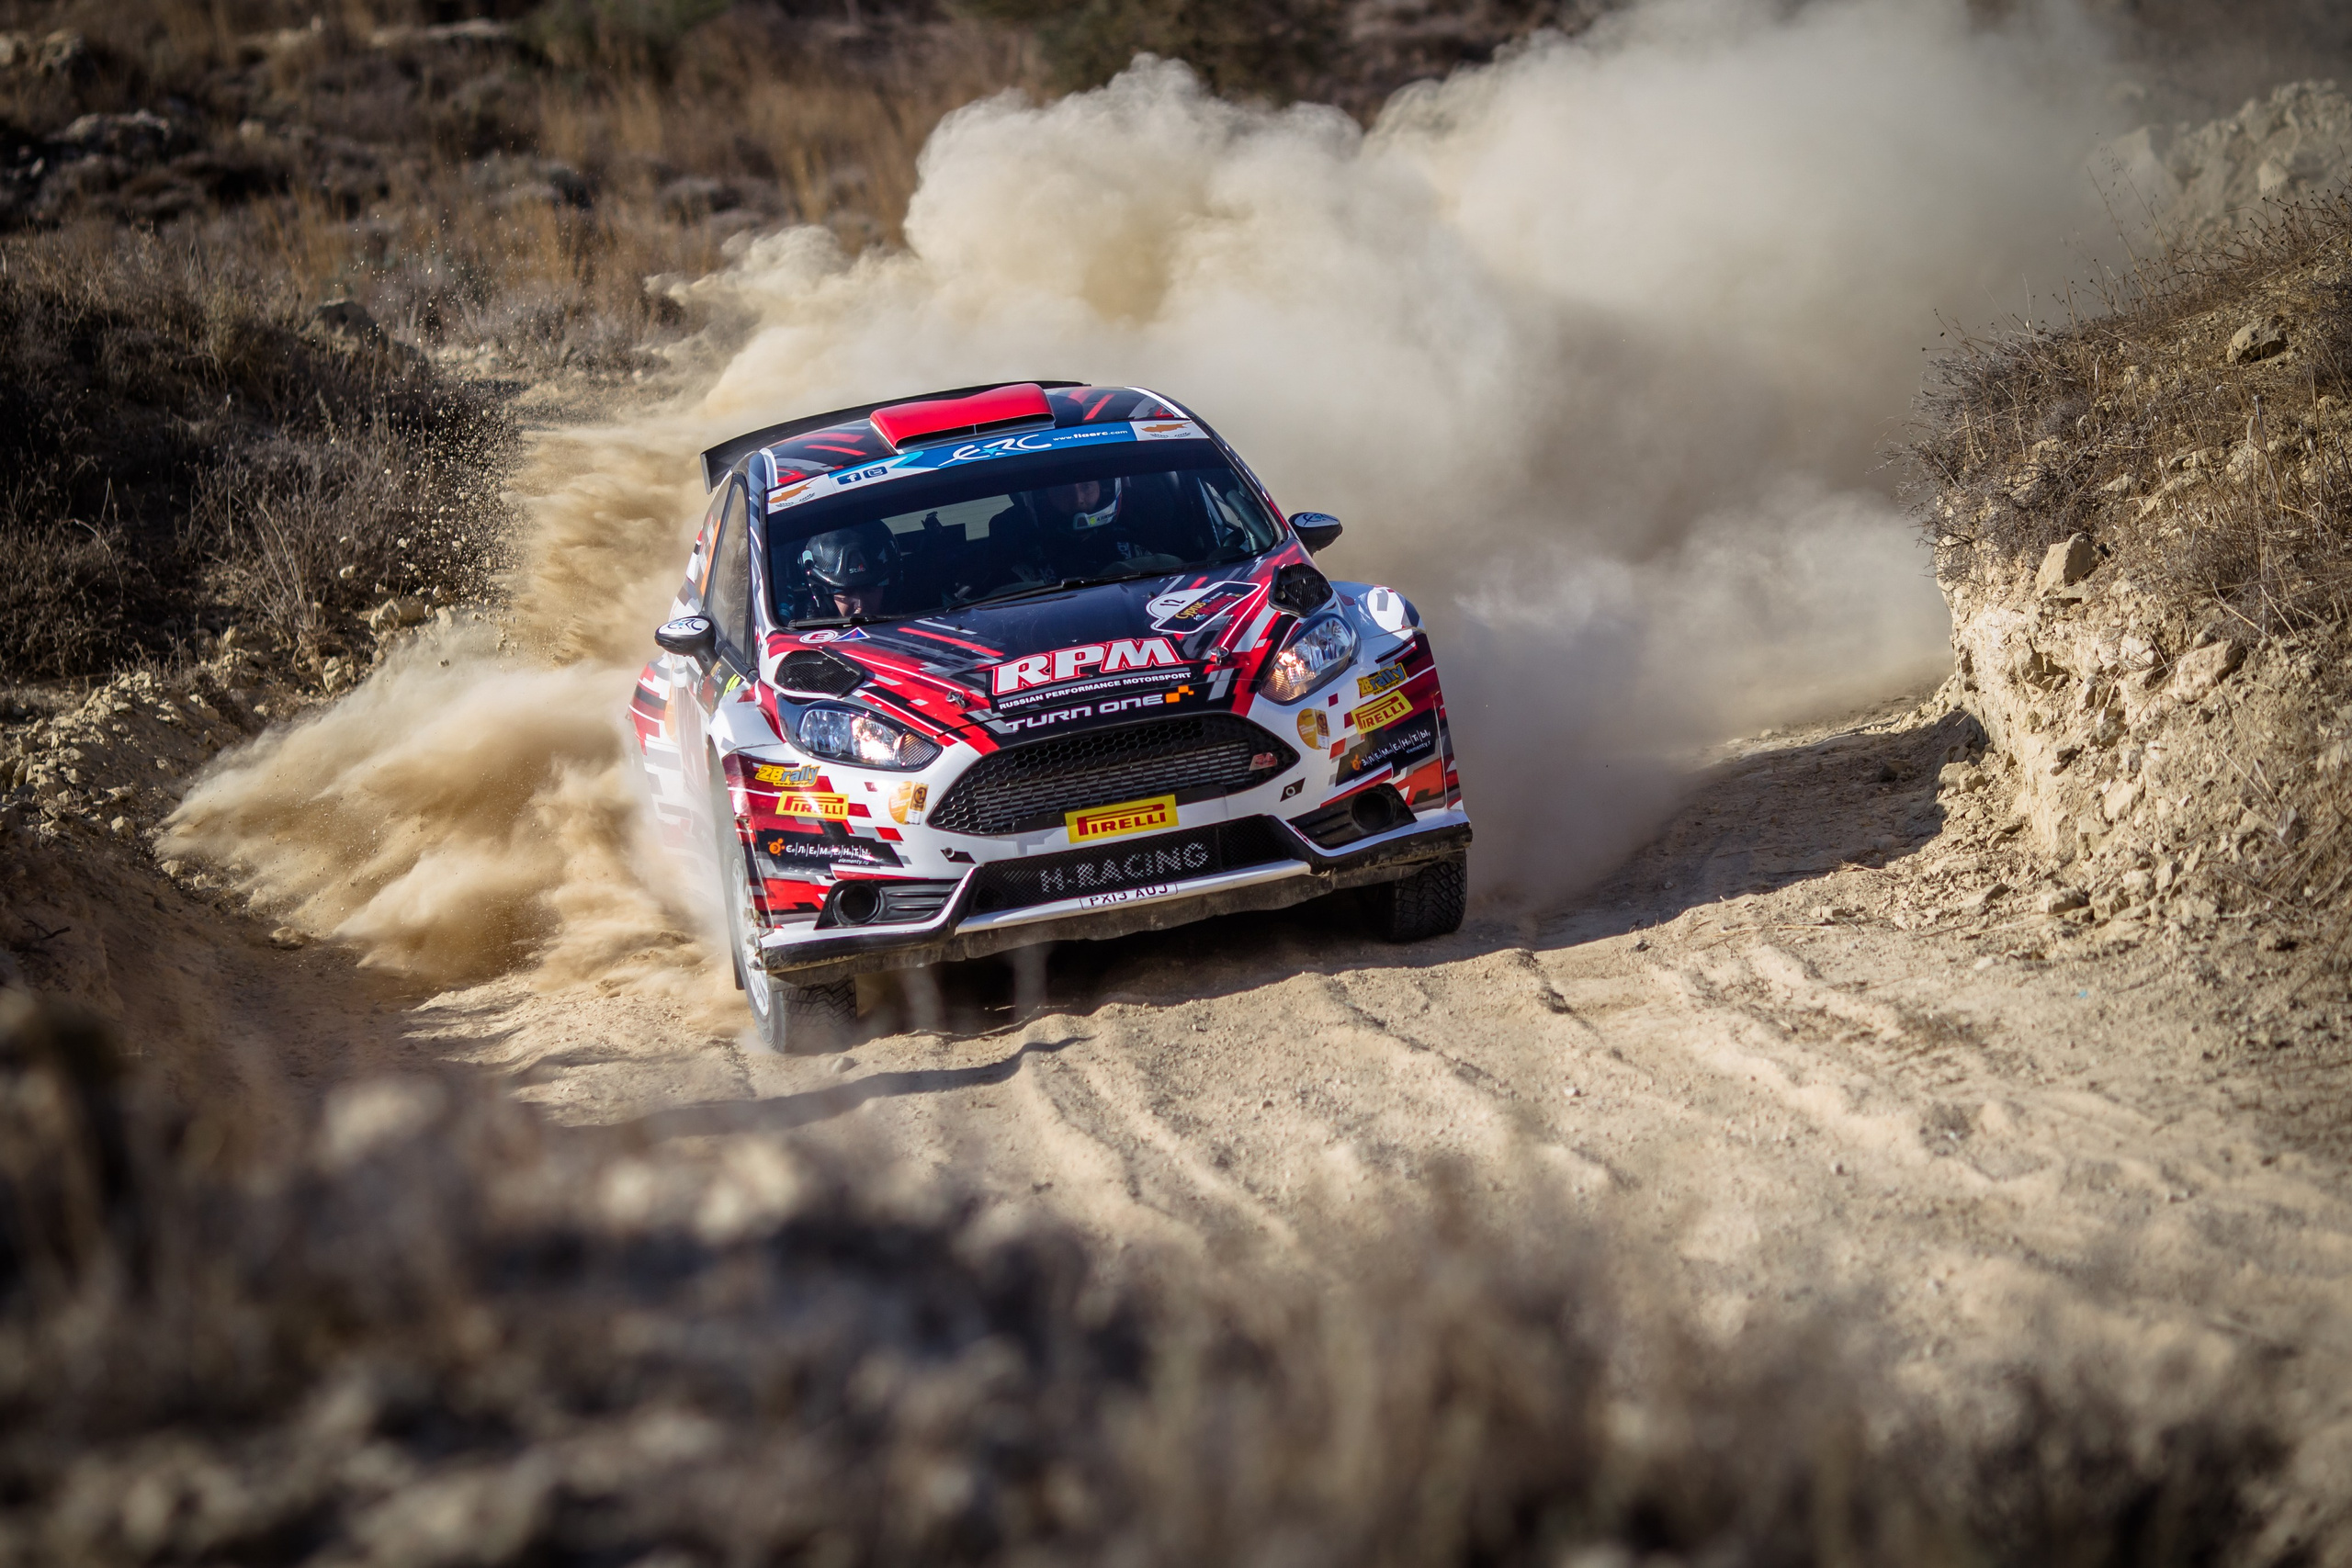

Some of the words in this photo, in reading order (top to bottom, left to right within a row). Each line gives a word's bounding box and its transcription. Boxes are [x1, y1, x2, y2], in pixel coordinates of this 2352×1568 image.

[1053, 430, 1128, 441] www.fiaerc.com
[938, 434, 1052, 467] ERC
[1159, 598, 1187, 607] 12
[1175, 601, 1207, 620] Cyprus
[667, 618, 703, 631] ERC
[992, 637, 1183, 696] RPM
[1358, 664, 1407, 695] 2Brally
[999, 694, 1045, 710] RUSSIAN
[1046, 680, 1122, 699] PERFORMANCE
[1124, 671, 1193, 685] MOTORSPORT
[1006, 705, 1092, 732] TURN
[1099, 694, 1164, 715] ONE
[1355, 694, 1408, 730] PIRELLI
[758, 765, 820, 784] 2Brally
[783, 795, 844, 816] PIRELLI
[1077, 803, 1167, 837] PIRELLI
[1089, 892, 1128, 907] PX13
